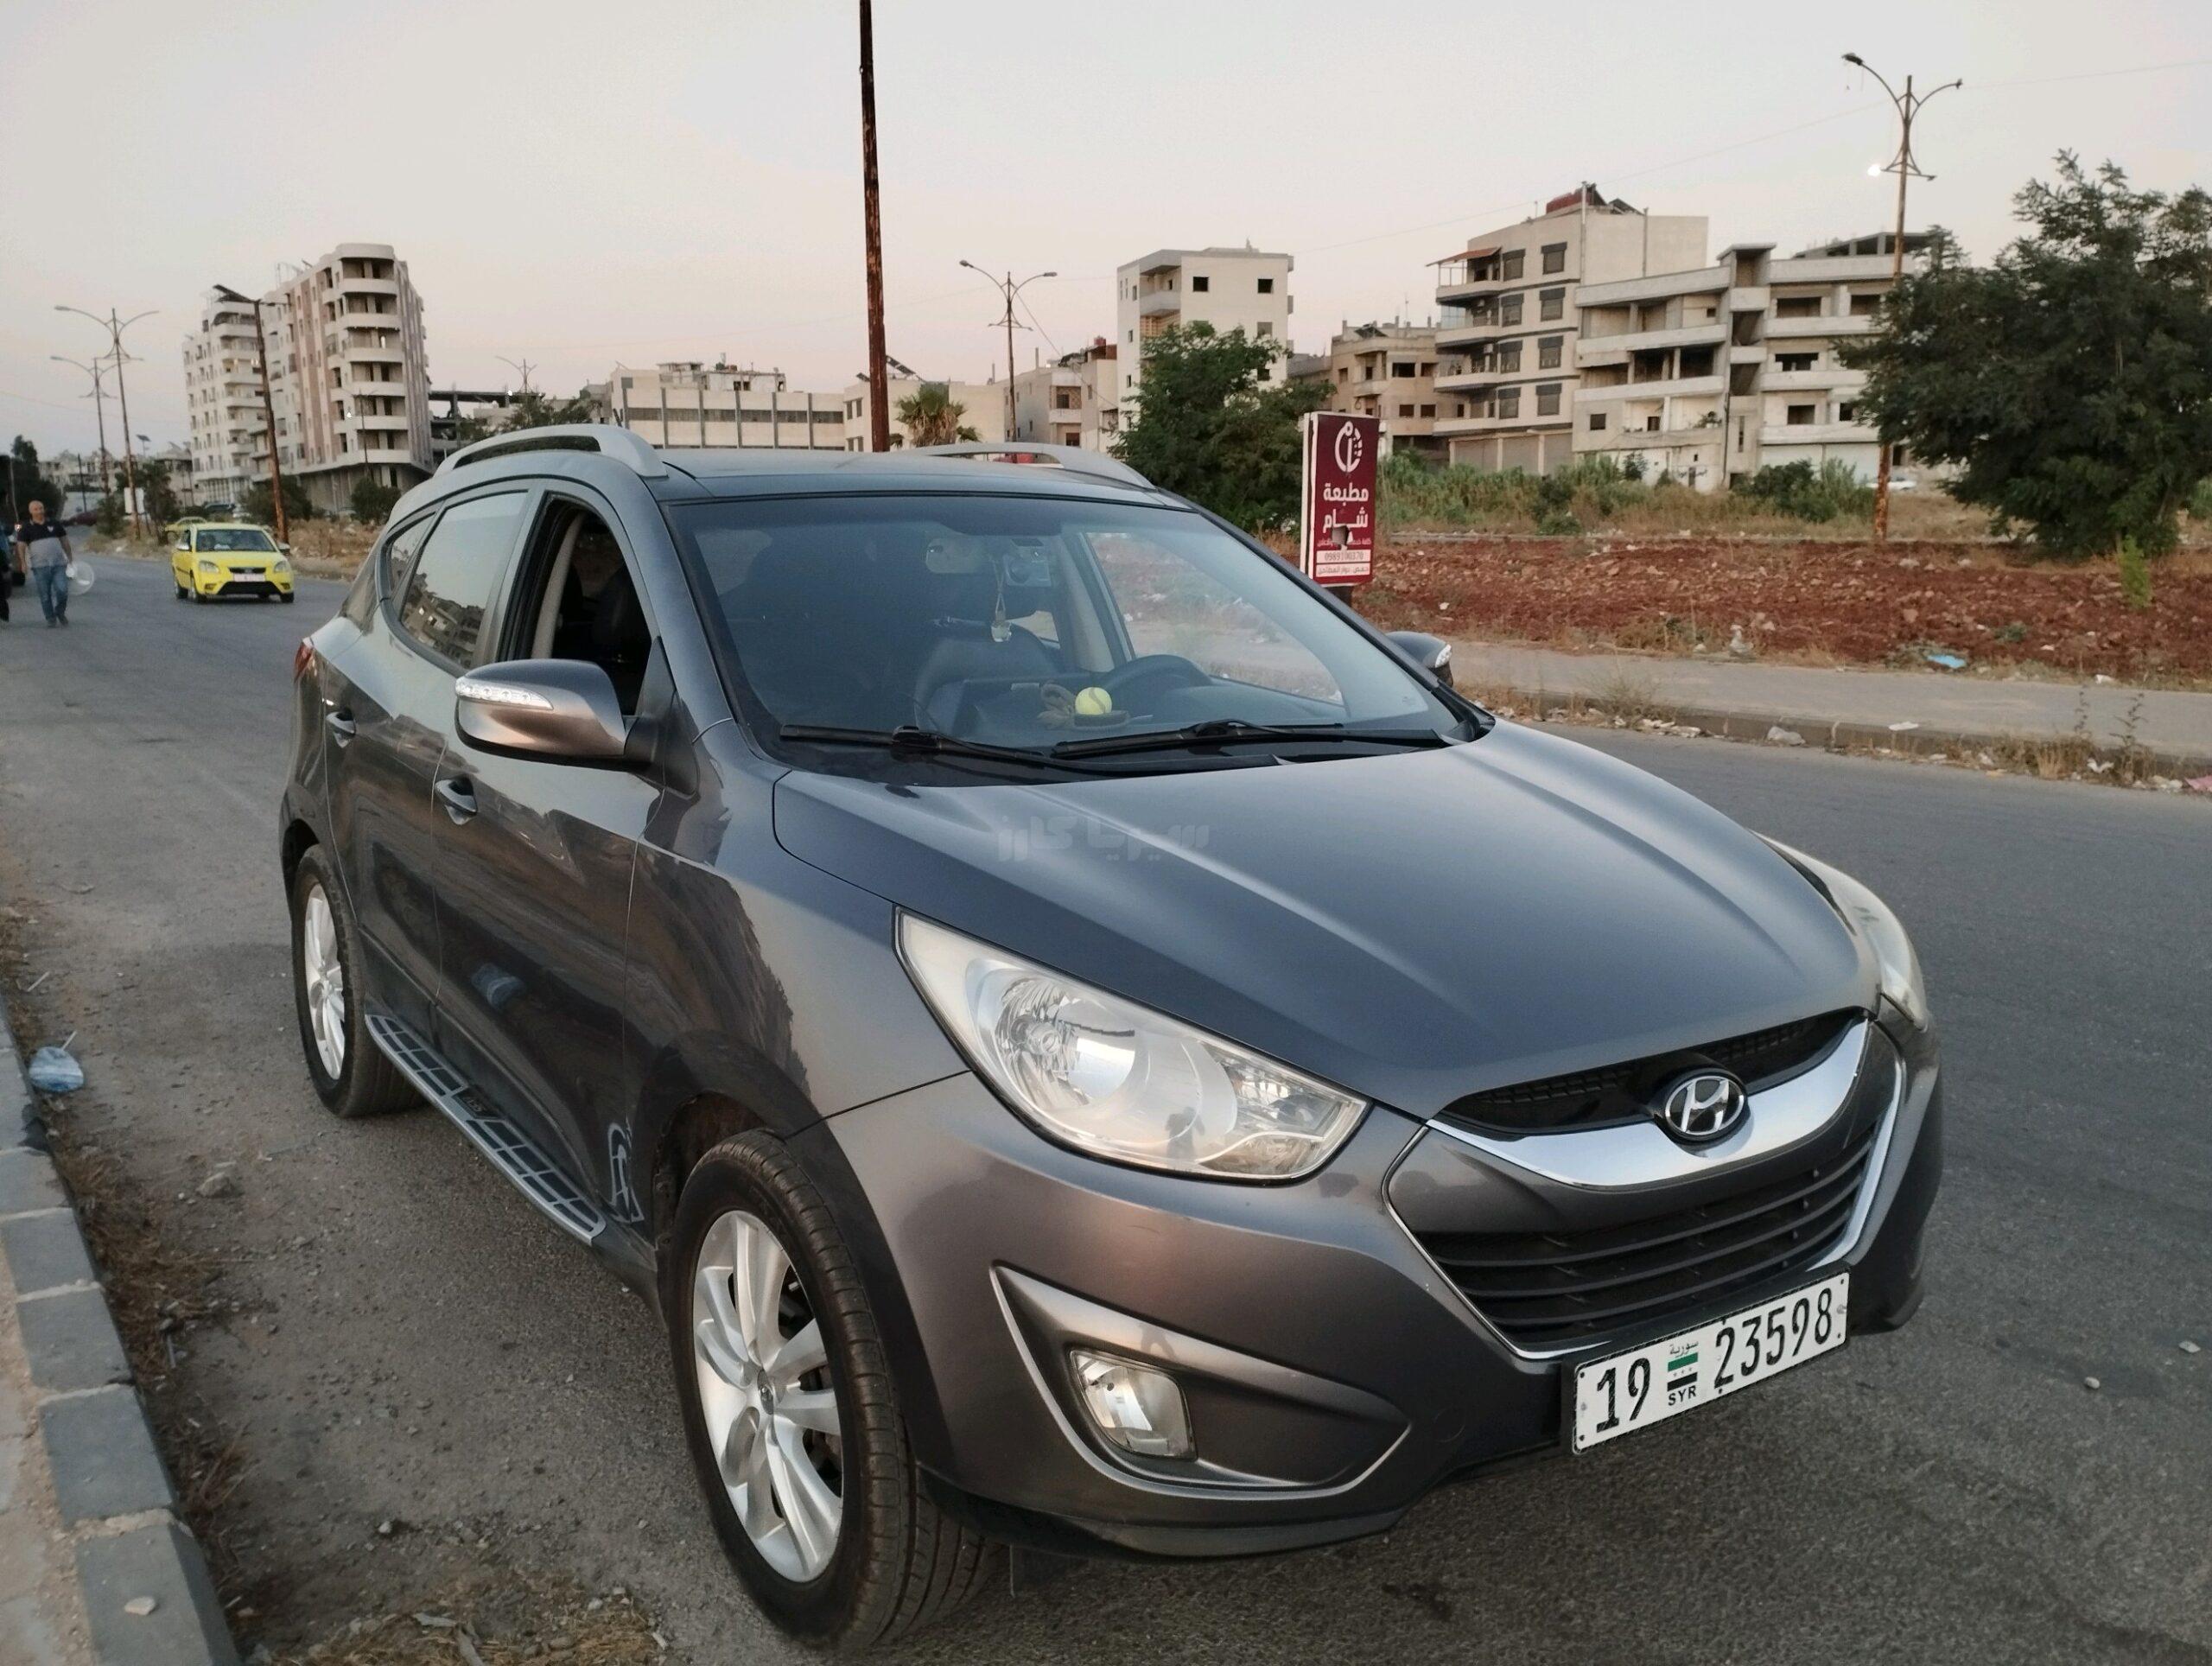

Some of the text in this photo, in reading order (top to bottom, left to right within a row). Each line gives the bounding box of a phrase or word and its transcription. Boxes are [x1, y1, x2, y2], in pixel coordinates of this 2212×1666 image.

[1323, 482, 1369, 506] مطبعة
[1323, 506, 1369, 533] شام
[1669, 1341, 1699, 1358] سورية
[1713, 1288, 1833, 1389] 23598
[1596, 1358, 1650, 1434] 19
[1668, 1385, 1696, 1406] SYR
